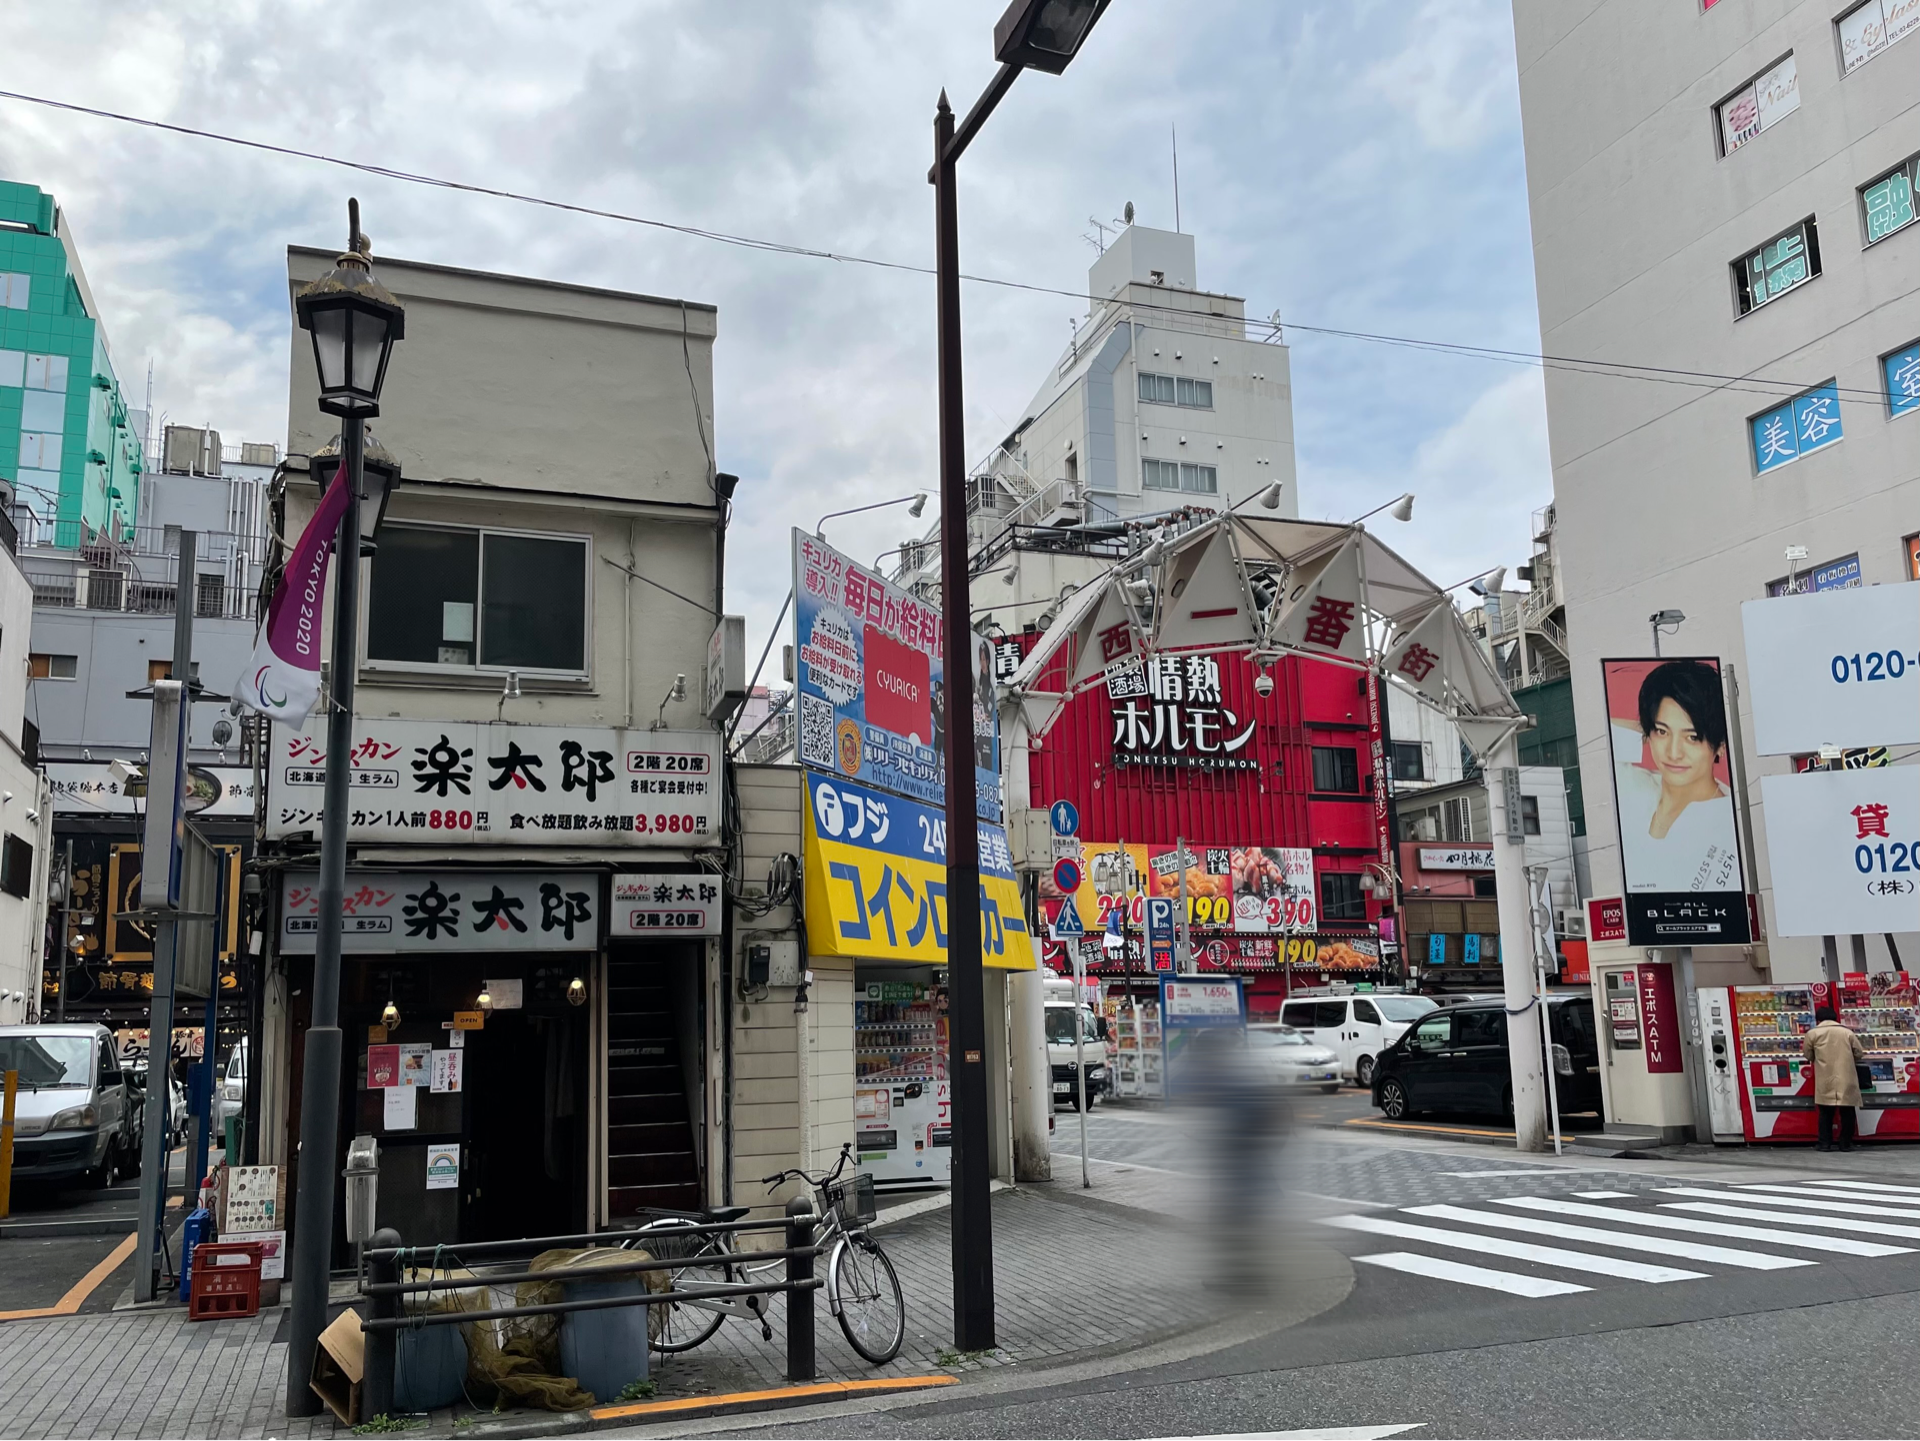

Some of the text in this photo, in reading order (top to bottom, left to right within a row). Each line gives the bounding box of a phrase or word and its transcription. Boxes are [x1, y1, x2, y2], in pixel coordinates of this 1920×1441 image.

[1760, 73, 1797, 112] Nail
[1760, 397, 1840, 466] 美容
[802, 540, 842, 578] キュリカ
[295, 539, 329, 656] TOKYO 2020
[820, 617, 850, 641] キュリカは
[811, 630, 857, 662] お給料日前に
[801, 645, 863, 686] お給料が受け取れる
[1147, 654, 1222, 703] 情熱
[1831, 650, 1920, 684] 0120-
[808, 666, 859, 699] 便利なカードです
[876, 668, 919, 704] CYURICA
[1110, 674, 1145, 695] 酒場
[1112, 701, 1256, 752] ホルモン
[287, 736, 402, 767] ジンスカン
[633, 755, 704, 771] 2階 20席
[359, 773, 394, 785] 生ラム
[410, 734, 616, 803] 楽太郎
[630, 779, 708, 796] 各種ご宴会受付中!
[841, 791, 890, 844] フジ
[1849, 803, 1890, 840] 貸
[919, 815, 1012, 873] 24営業
[288, 885, 395, 914] ジンスカン
[653, 882, 718, 904] 楽太郎
[356, 920, 387, 930] 生ラム
[402, 880, 592, 941] 楽太郎
[636, 913, 699, 926] 2階 20席
[828, 862, 1027, 957] コインロカー
[1266, 897, 1312, 926] 390
[1603, 909, 1621, 918] EPOS
[1647, 908, 1727, 918] BLACK
[1154, 952, 1171, 970] 満
[1278, 939, 1316, 963] 190
[1644, 988, 1662, 1063] エポスATM
[447, 1052, 457, 1079] 昼呑み
